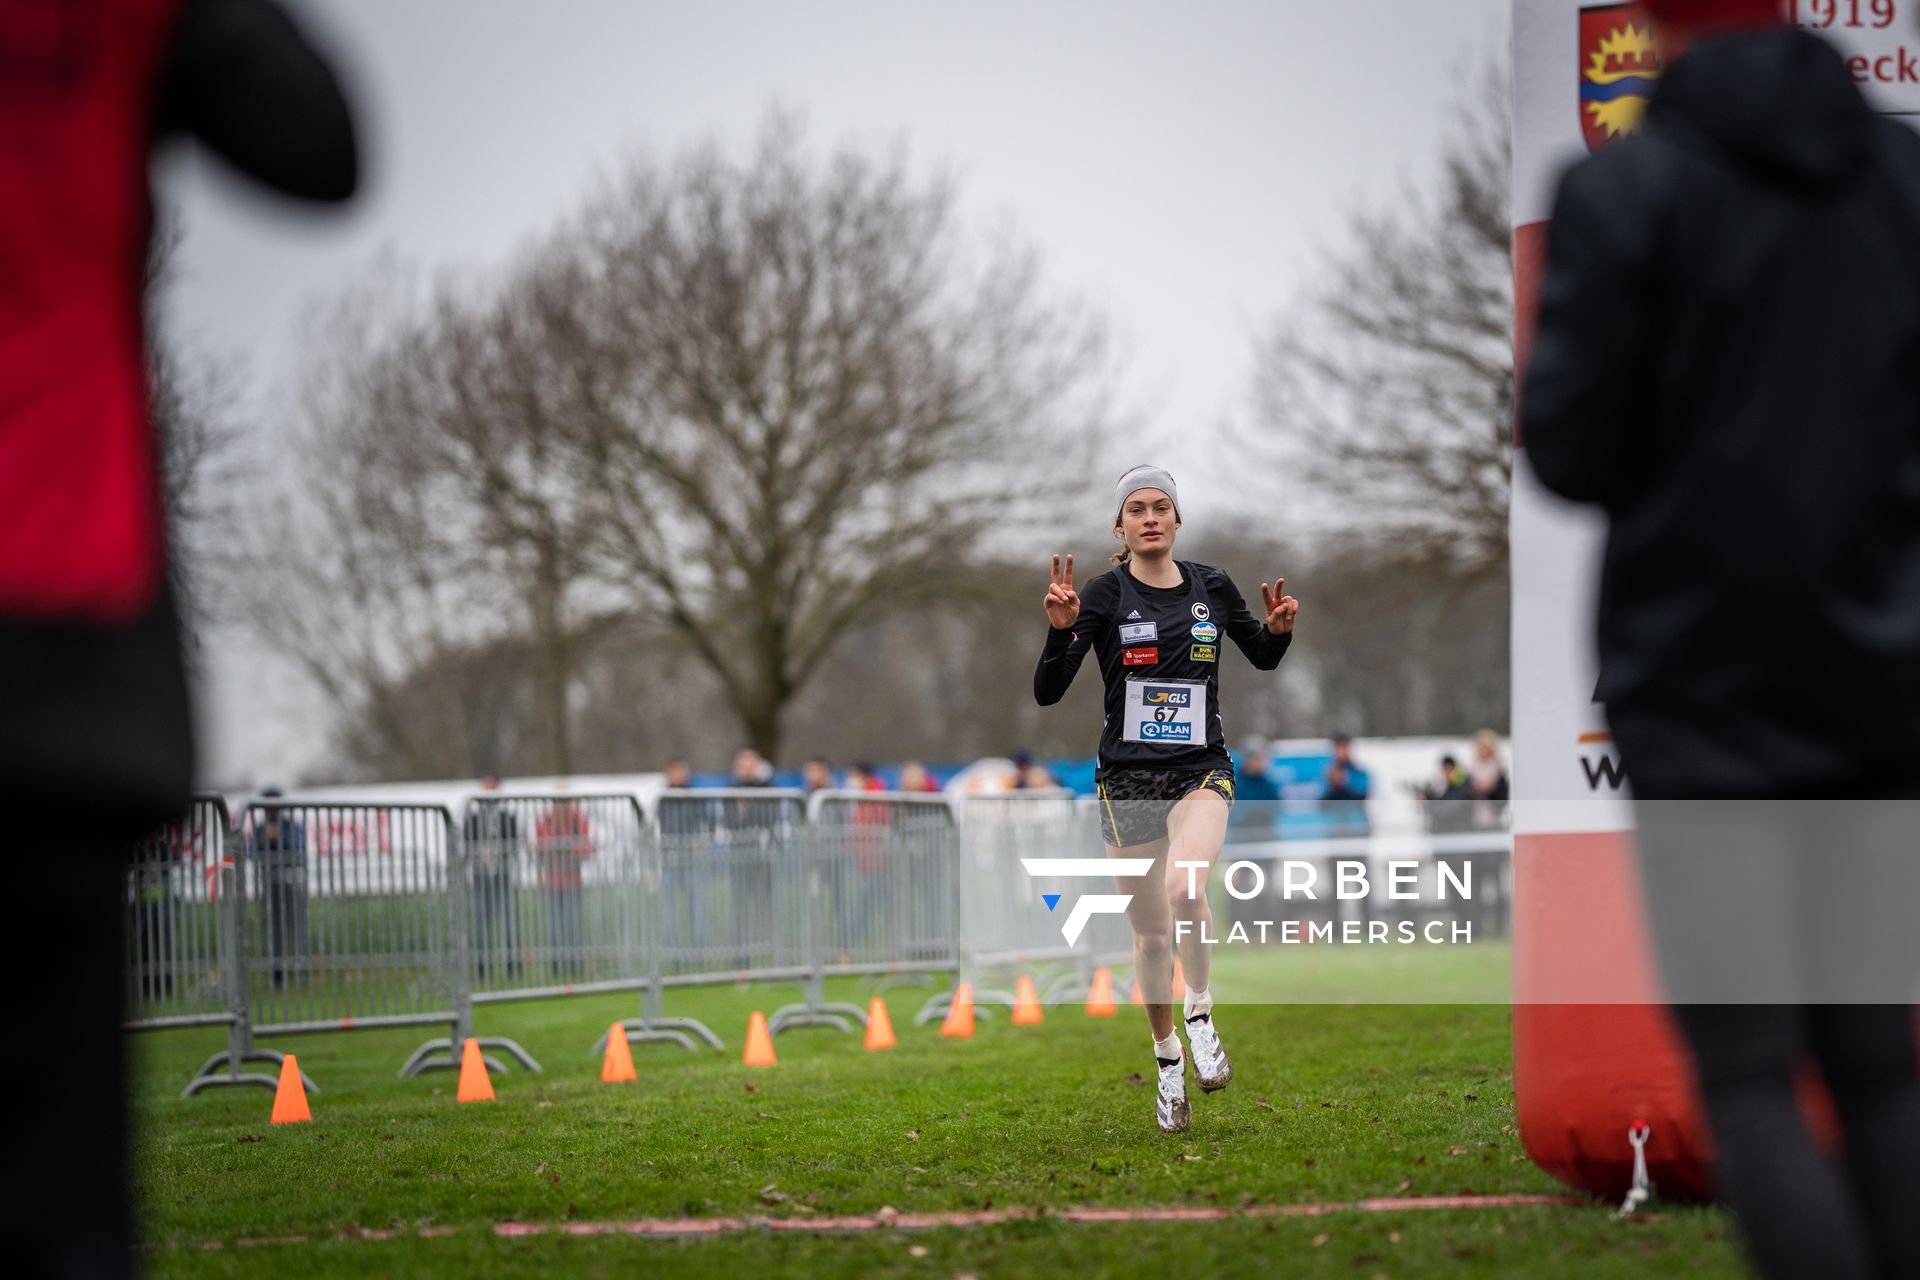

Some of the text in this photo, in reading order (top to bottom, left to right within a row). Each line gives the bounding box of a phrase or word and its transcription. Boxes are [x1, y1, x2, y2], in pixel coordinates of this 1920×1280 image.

[1789, 0, 1896, 29] 1919
[1168, 693, 1188, 704] GLS
[1154, 707, 1179, 722] 67
[1161, 725, 1190, 734] PLAN
